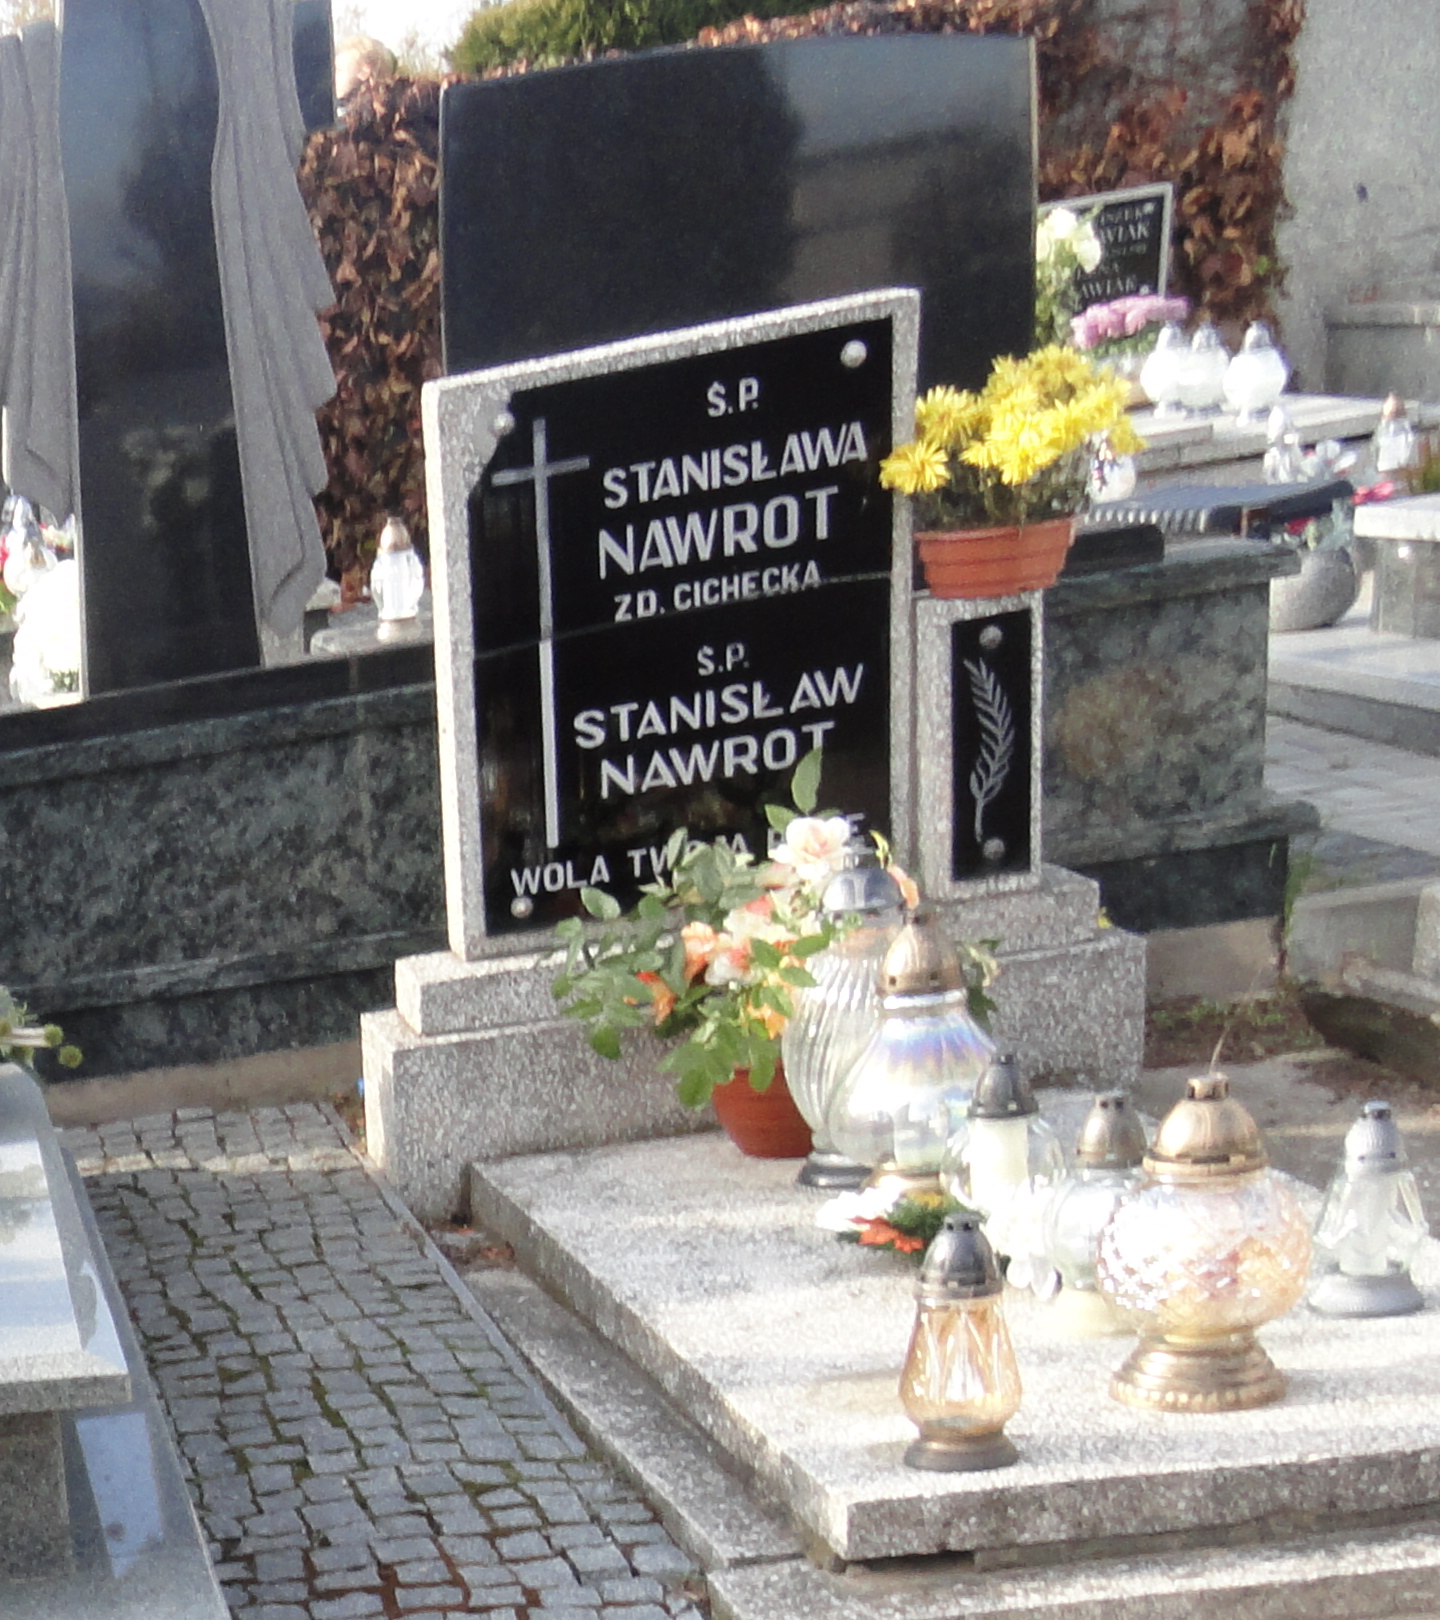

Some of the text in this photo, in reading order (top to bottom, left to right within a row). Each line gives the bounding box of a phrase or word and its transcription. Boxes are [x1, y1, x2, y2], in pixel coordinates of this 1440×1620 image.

[602, 420, 868, 509] STANISŁAWA
[599, 486, 839, 580] NAWROT
[614, 560, 821, 623] ZD. CICHECKA
[573, 662, 864, 749] STANISŁAW
[600, 721, 835, 799] NAWROT
[511, 855, 610, 896] WOLA
